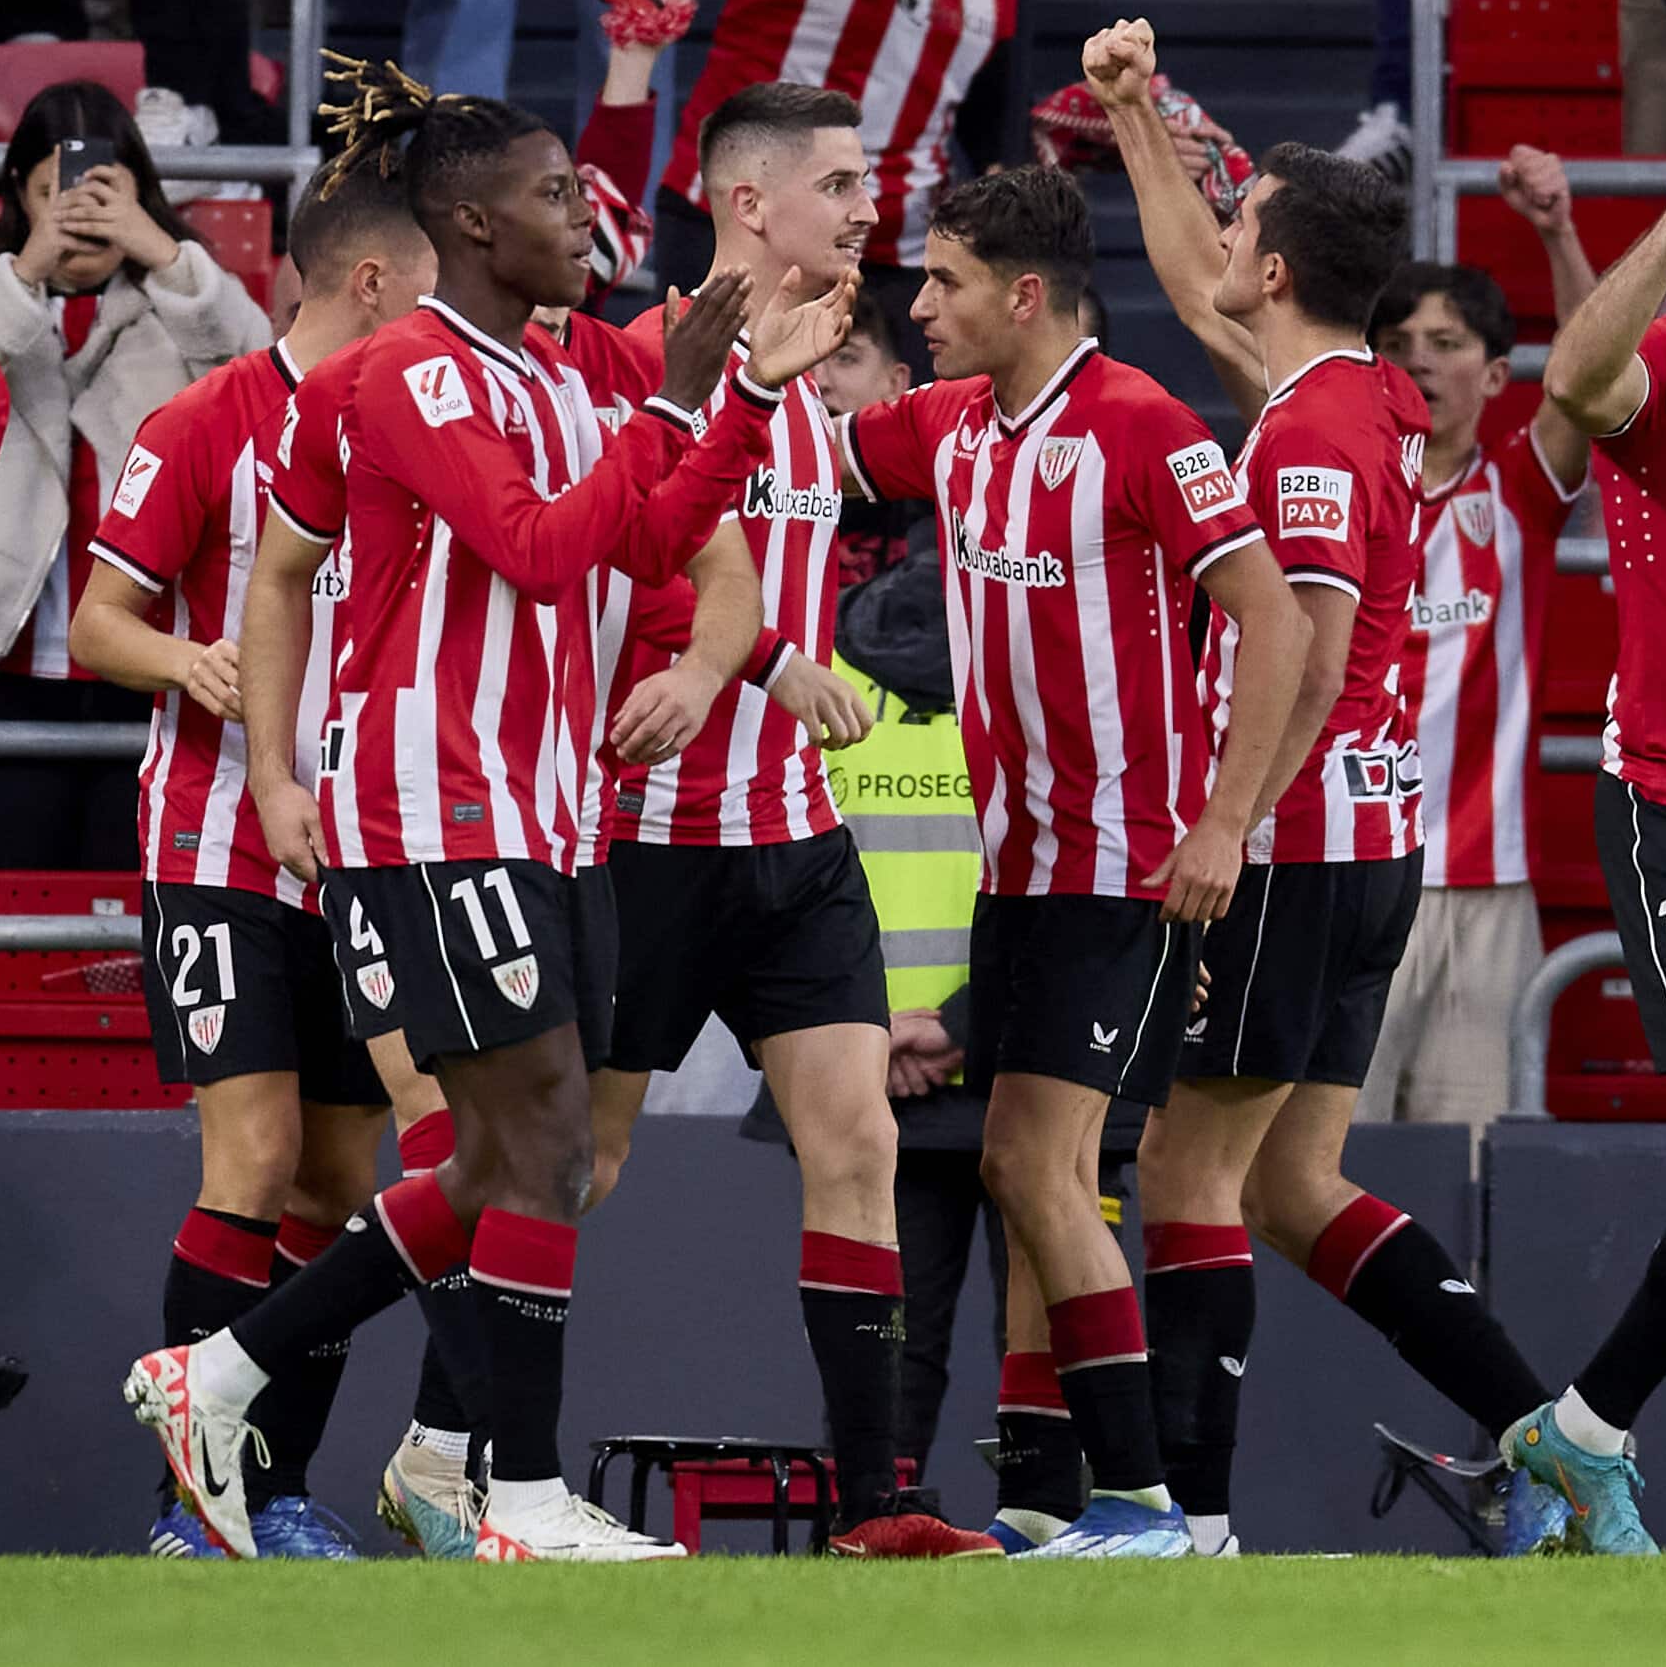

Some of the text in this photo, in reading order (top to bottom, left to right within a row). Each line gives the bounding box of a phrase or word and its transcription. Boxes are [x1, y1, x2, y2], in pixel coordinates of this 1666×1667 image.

[1279, 475, 1339, 497] B2Bin
[1286, 501, 1330, 523] PAY
[953, 509, 1063, 584] Kutxabank
[346, 895, 383, 957] 4
[450, 865, 533, 961] 11
[171, 922, 237, 1008] 21
